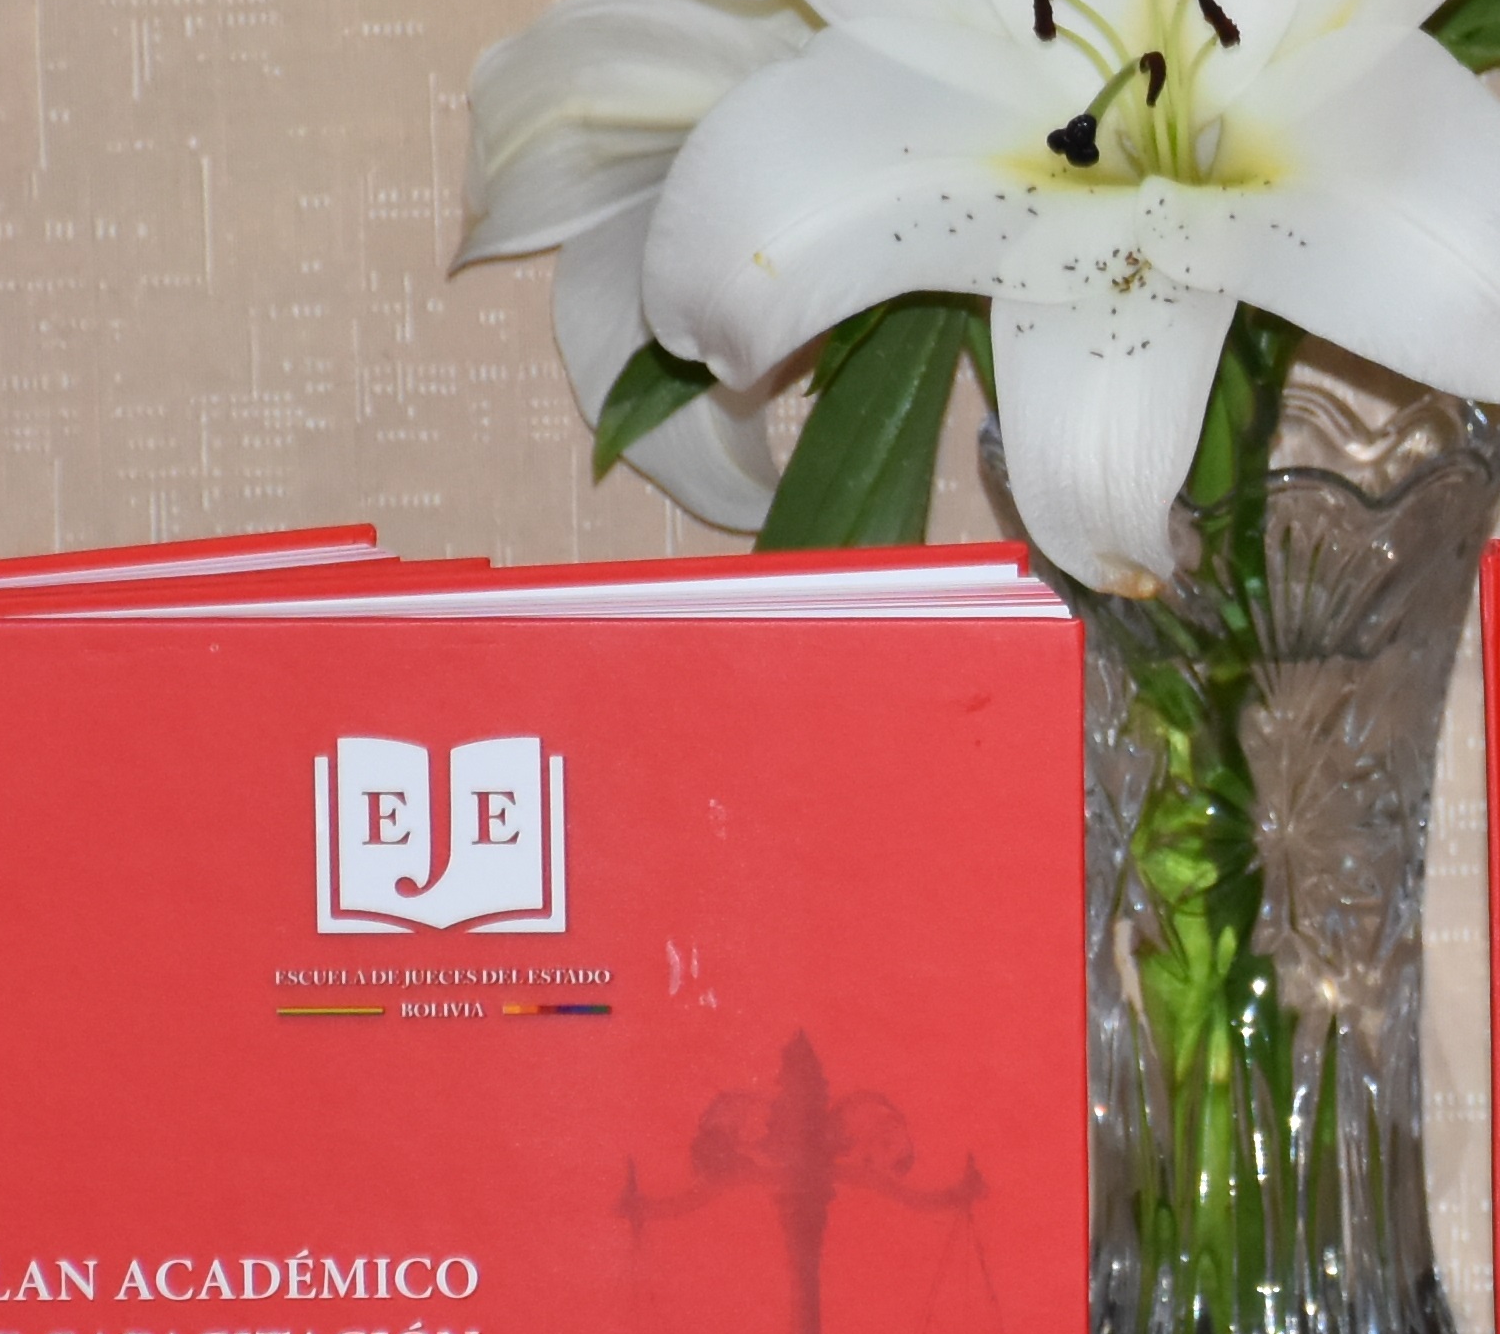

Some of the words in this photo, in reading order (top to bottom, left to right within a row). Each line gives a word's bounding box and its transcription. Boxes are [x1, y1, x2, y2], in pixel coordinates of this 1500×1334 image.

[275, 969, 367, 986] ESCUELA
[372, 970, 400, 985] DE
[402, 970, 477, 988] JUECES
[482, 970, 522, 985] DEL
[528, 969, 611, 985] ESTADO
[401, 1003, 484, 1018] BOLIVIA
[115, 1250, 479, 1300] ACADÉMICO
